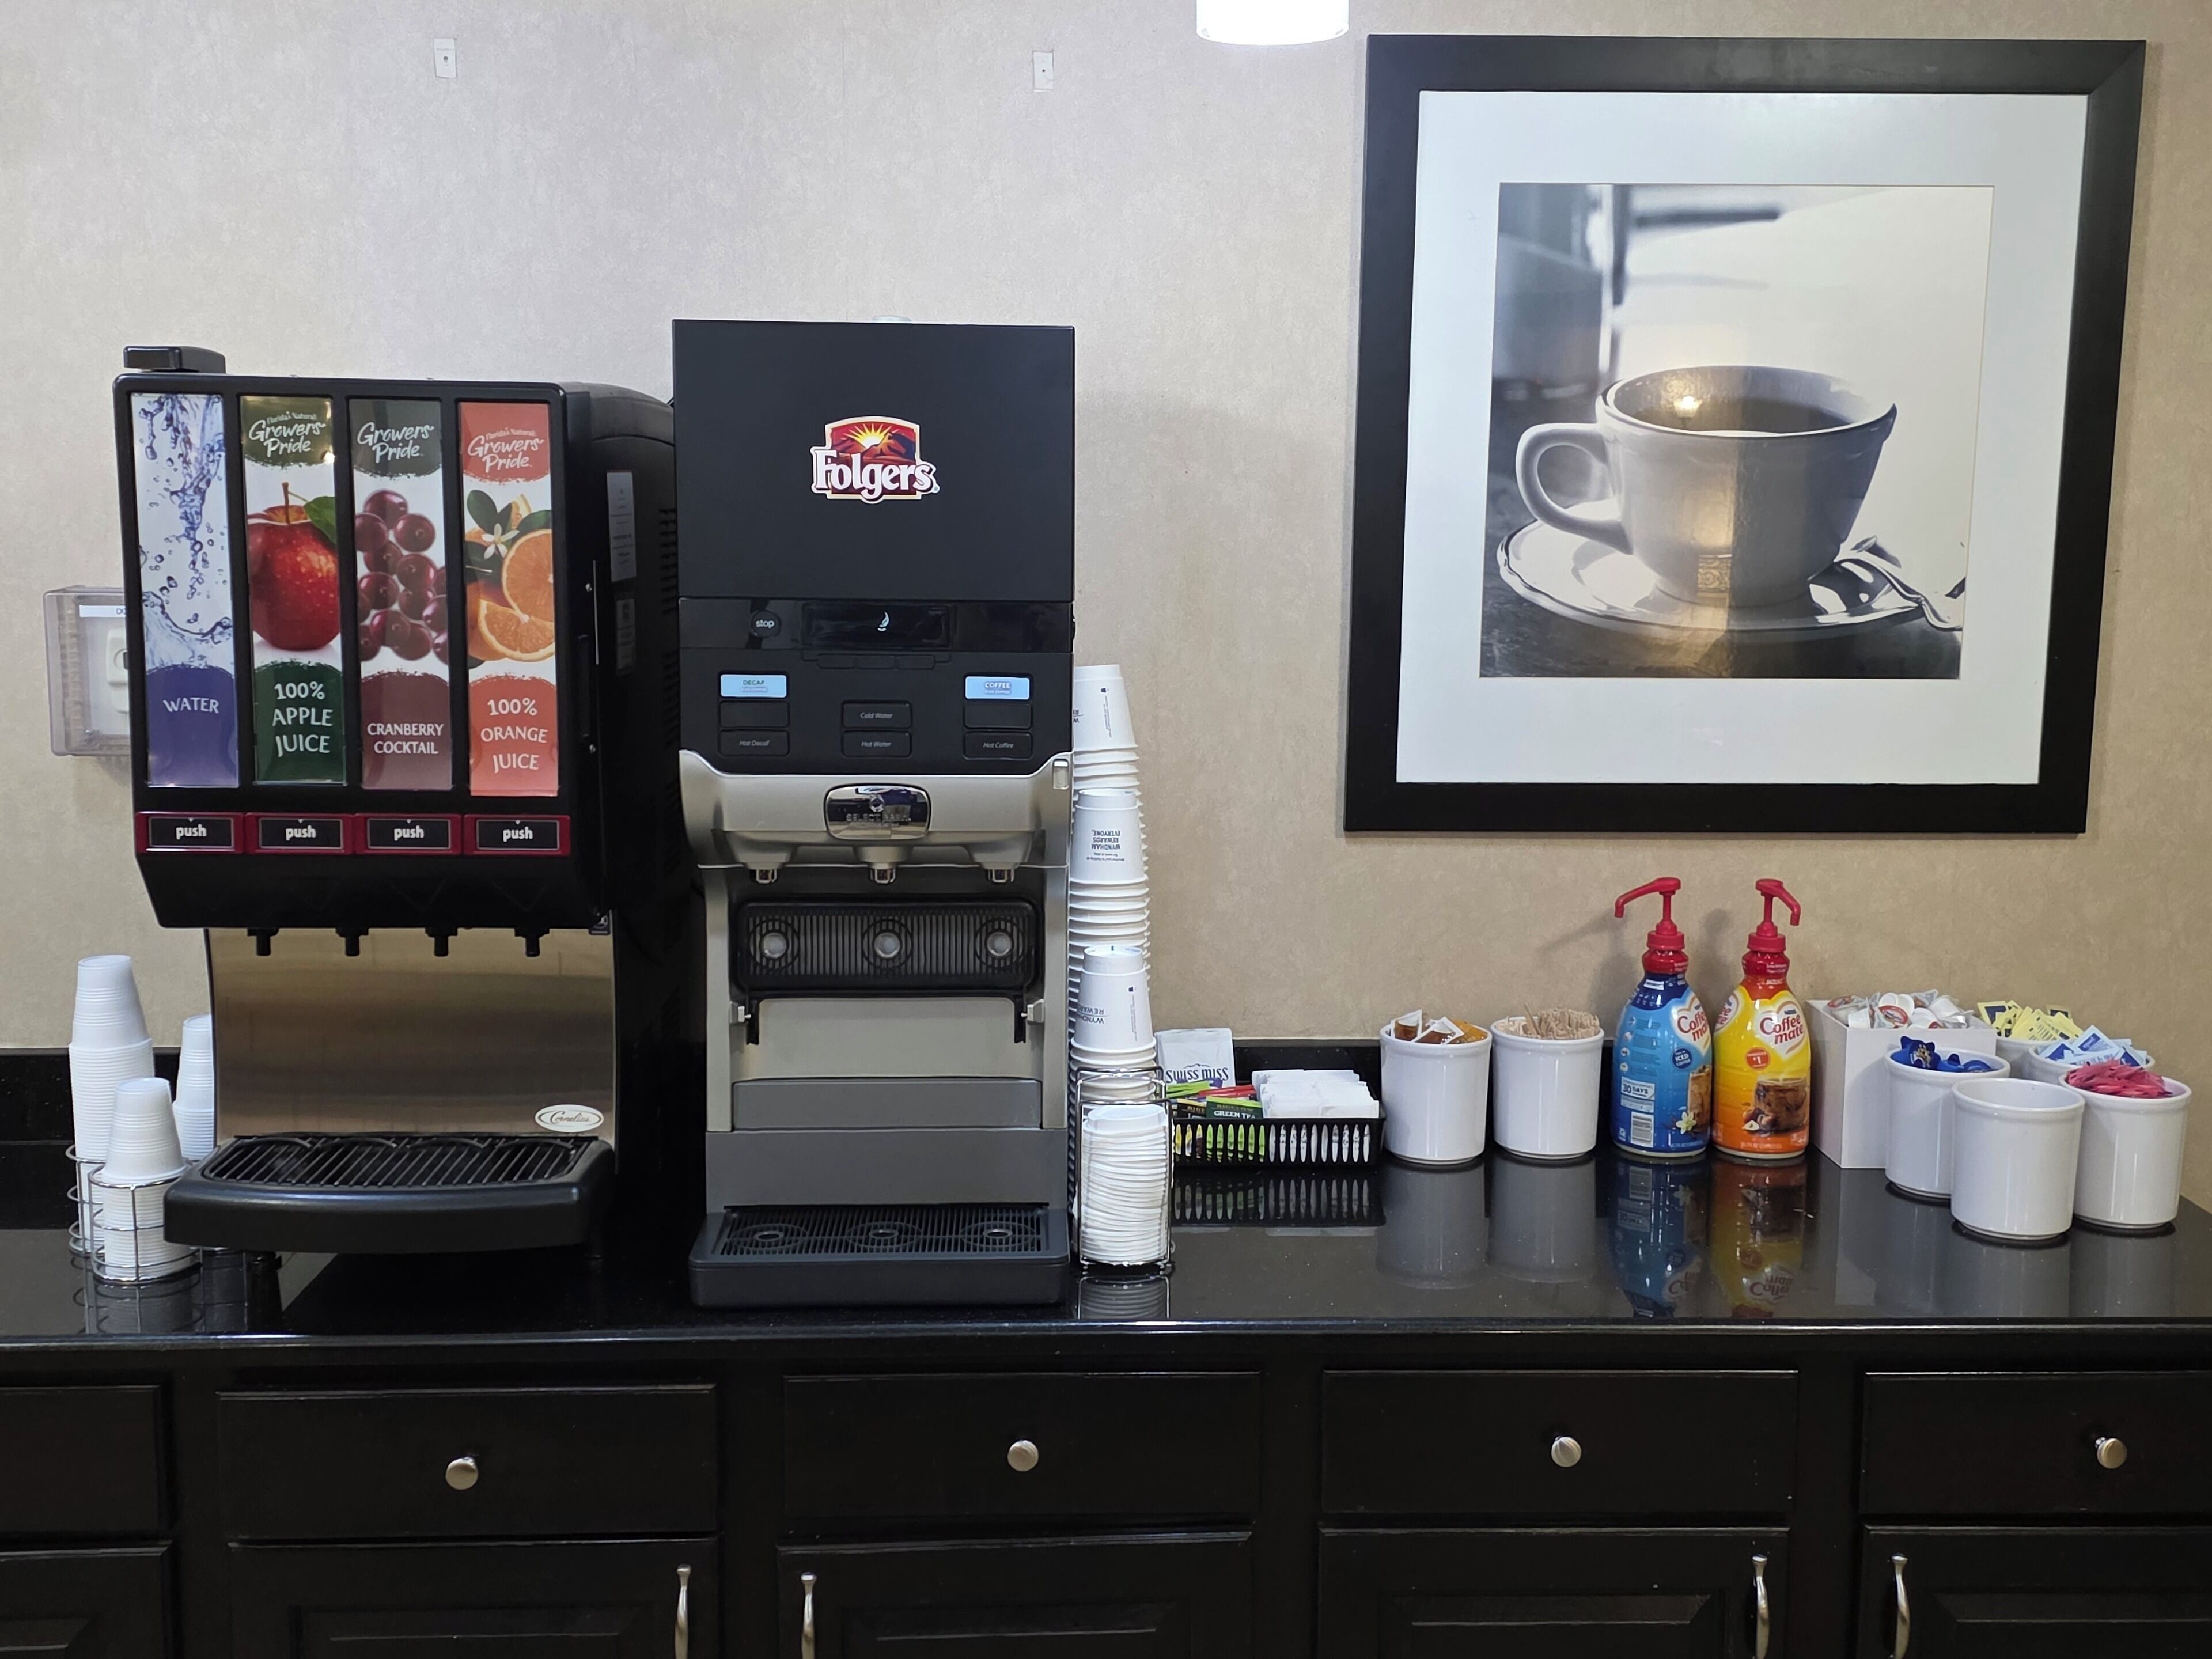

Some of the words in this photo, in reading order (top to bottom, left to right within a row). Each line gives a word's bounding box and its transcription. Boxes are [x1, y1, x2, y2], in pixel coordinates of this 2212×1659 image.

[263, 436, 311, 457] Pride
[372, 440, 420, 463] Pride
[482, 452, 529, 473] Pride
[815, 450, 933, 500] Folgers
[755, 619, 775, 629] stop
[274, 681, 325, 700] 100%
[163, 697, 219, 714] WATER
[487, 698, 537, 717] 100%
[272, 707, 333, 727] APPLE
[367, 723, 444, 737] CRANBERRY
[480, 726, 548, 743] ORANGE
[275, 734, 330, 757] JUICE
[374, 741, 438, 755] COCKTAIL
[493, 753, 540, 773] JUICE
[176, 824, 207, 840] push
[285, 825, 316, 841] push
[393, 825, 425, 841] push
[502, 827, 533, 842] push
[1760, 1014, 1801, 1035] Coffee
[1774, 1024, 1804, 1044] mate
[1623, 1084, 1631, 1094] 30
[1632, 1086, 1649, 1095] DAYS
[550, 1110, 590, 1124] Cornelius
[1214, 1110, 1240, 1118] GREEN
